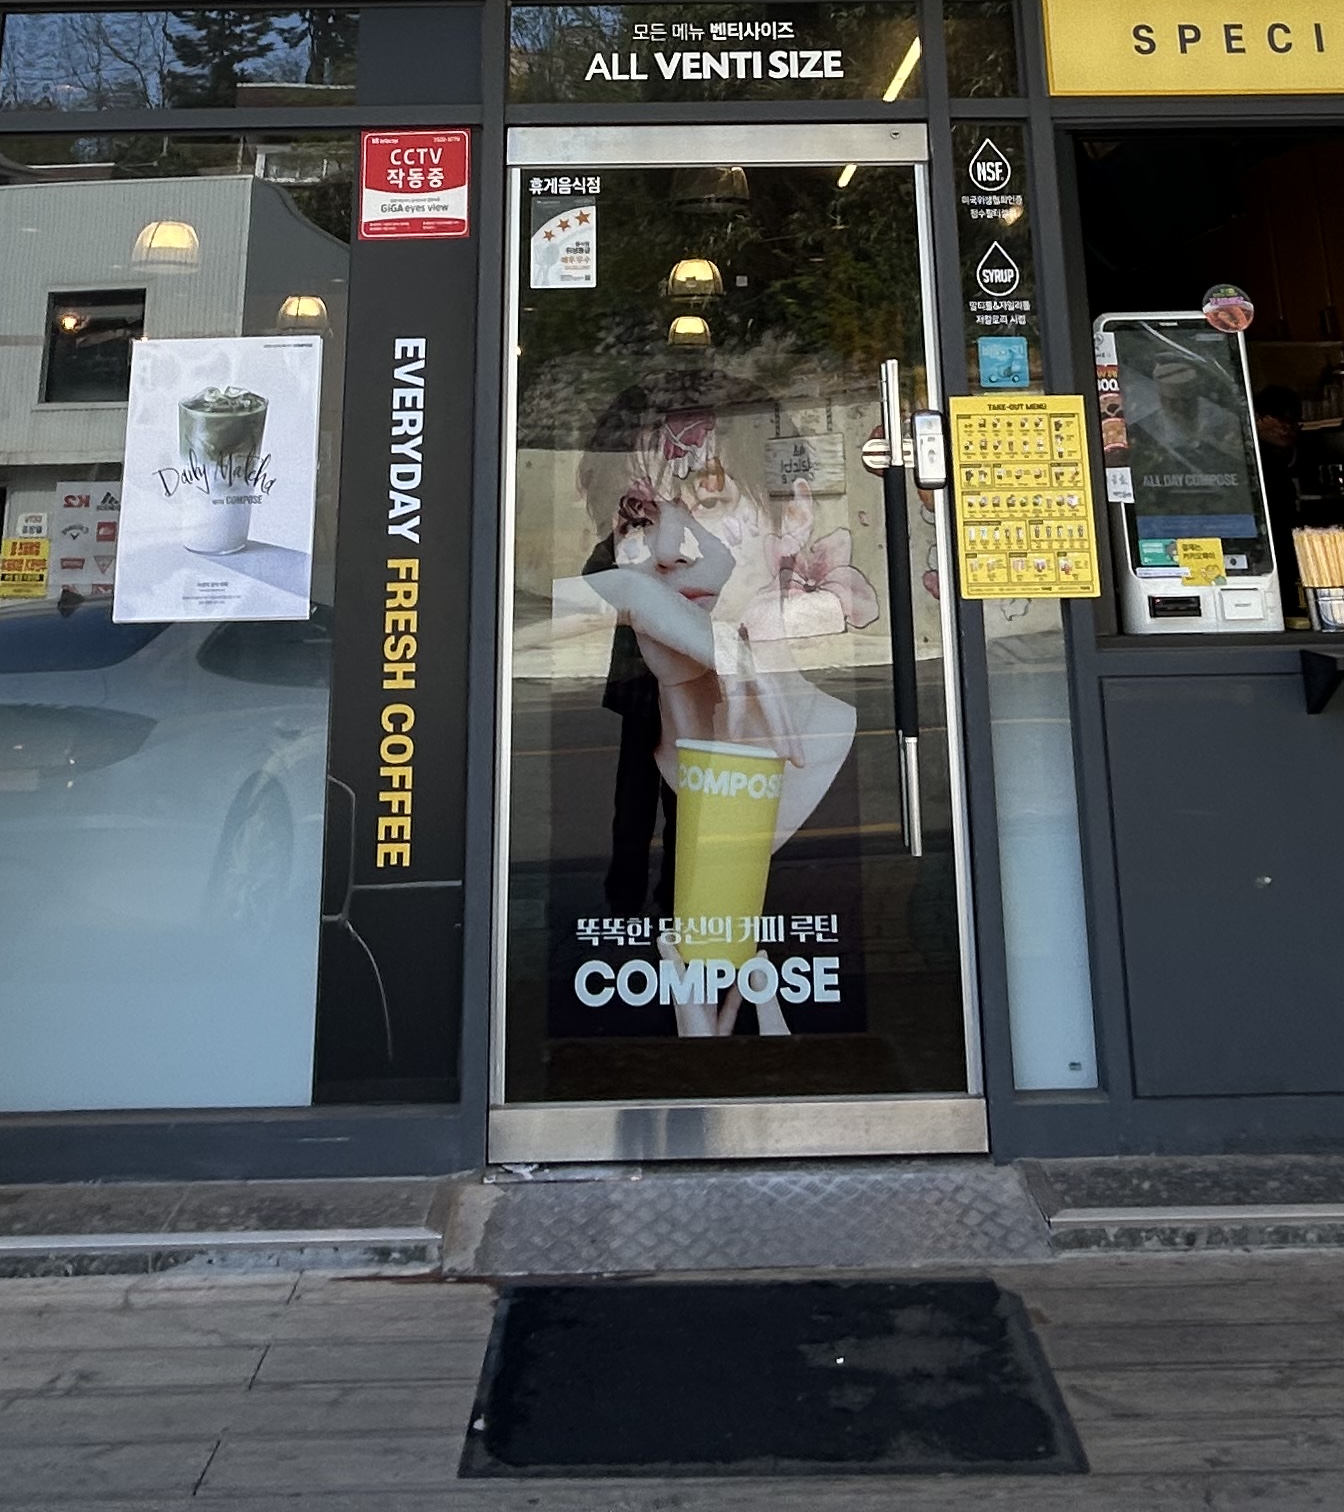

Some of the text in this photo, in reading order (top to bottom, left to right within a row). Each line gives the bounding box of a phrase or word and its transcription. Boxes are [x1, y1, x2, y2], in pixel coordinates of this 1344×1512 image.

[632, 21, 795, 41] 모든 메뉴 벤티사이즈
[585, 49, 844, 81] ALL VENTI SIZE
[390, 147, 443, 165] CCTV
[387, 168, 444, 189] 작동중
[529, 176, 601, 195] 휴게음식점
[427, 203, 449, 212] view
[982, 269, 1014, 284] SYRUP
[152, 444, 276, 497] Daily Matcha
[376, 337, 426, 868] EVERYDAY FRESH COFFEE
[679, 763, 784, 799] COMPOS
[575, 913, 839, 946] 똑똑한 당신의 커피 루틴
[574, 955, 841, 1008] COMPOSE
